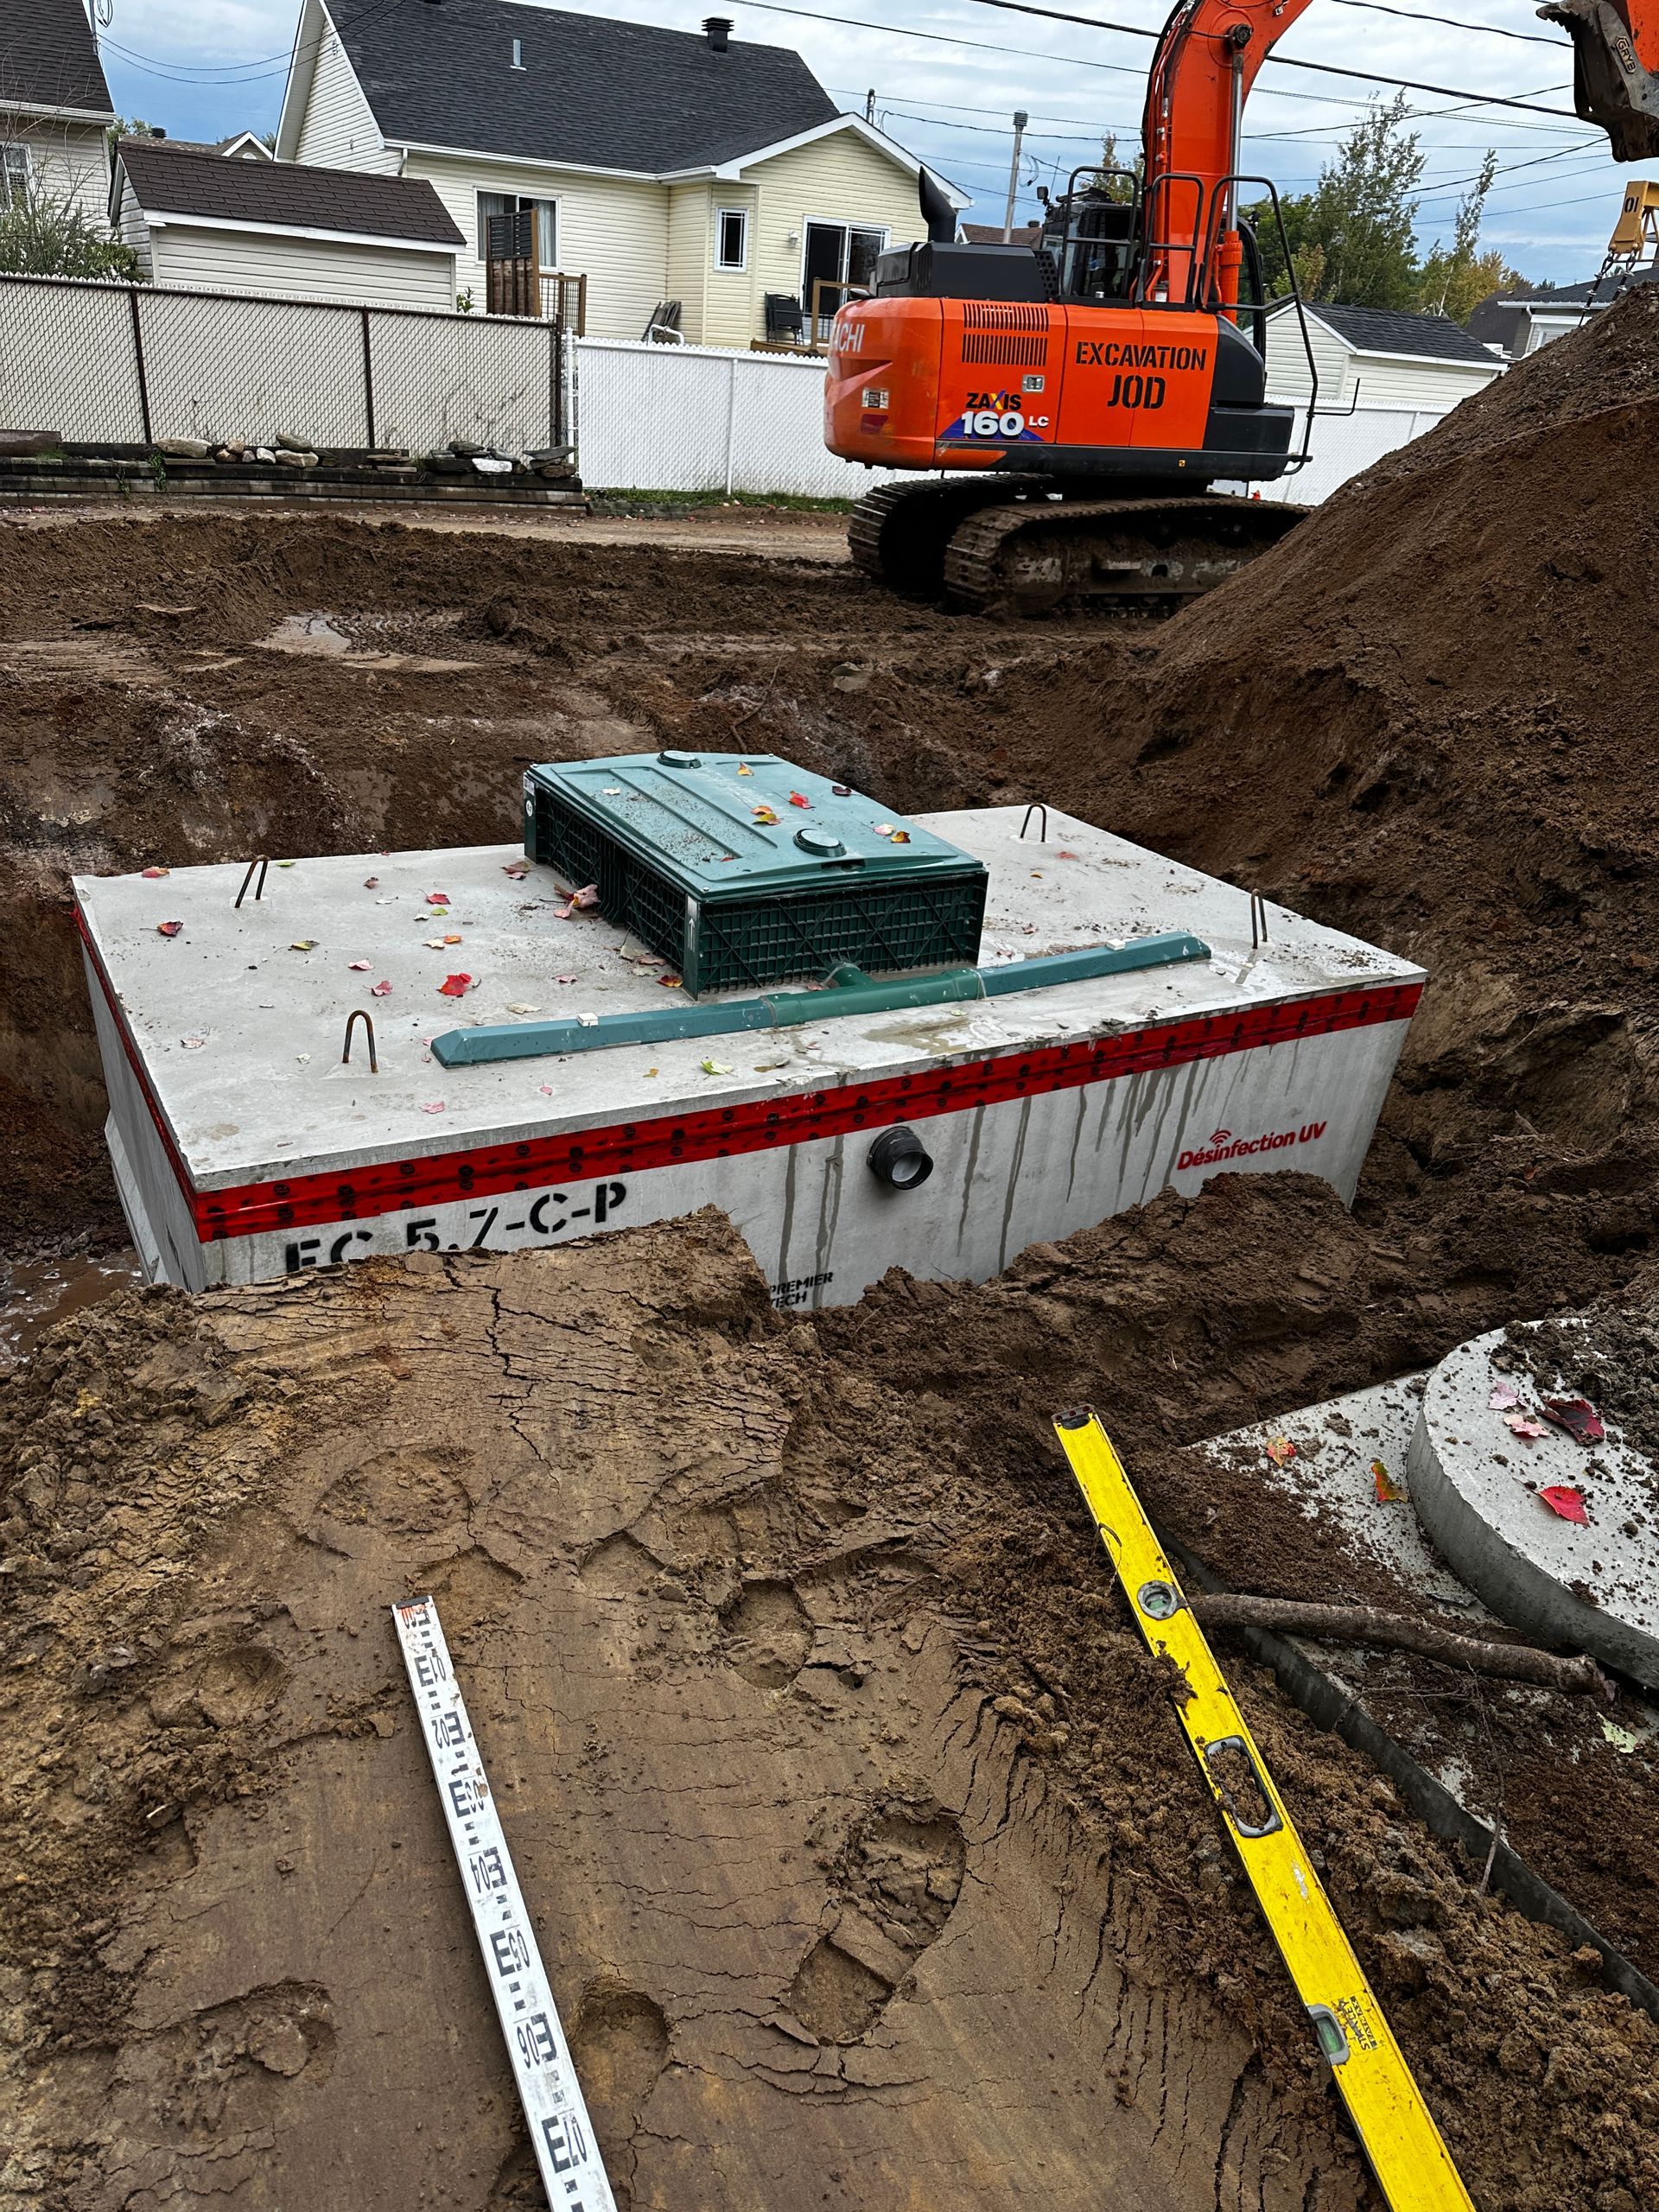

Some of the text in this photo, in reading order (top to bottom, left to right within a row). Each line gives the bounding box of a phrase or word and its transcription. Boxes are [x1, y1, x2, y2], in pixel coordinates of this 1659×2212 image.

[1618, 40, 1637, 71] GRYB
[832, 322, 865, 353] ACHI
[1076, 341, 1207, 371] EXCAVATION
[966, 390, 1022, 410] ZAXIS
[1107, 374, 1166, 409] JOD
[961, 410, 1050, 436] 160 LC
[1177, 1121, 1328, 1171] Désinfection UV
